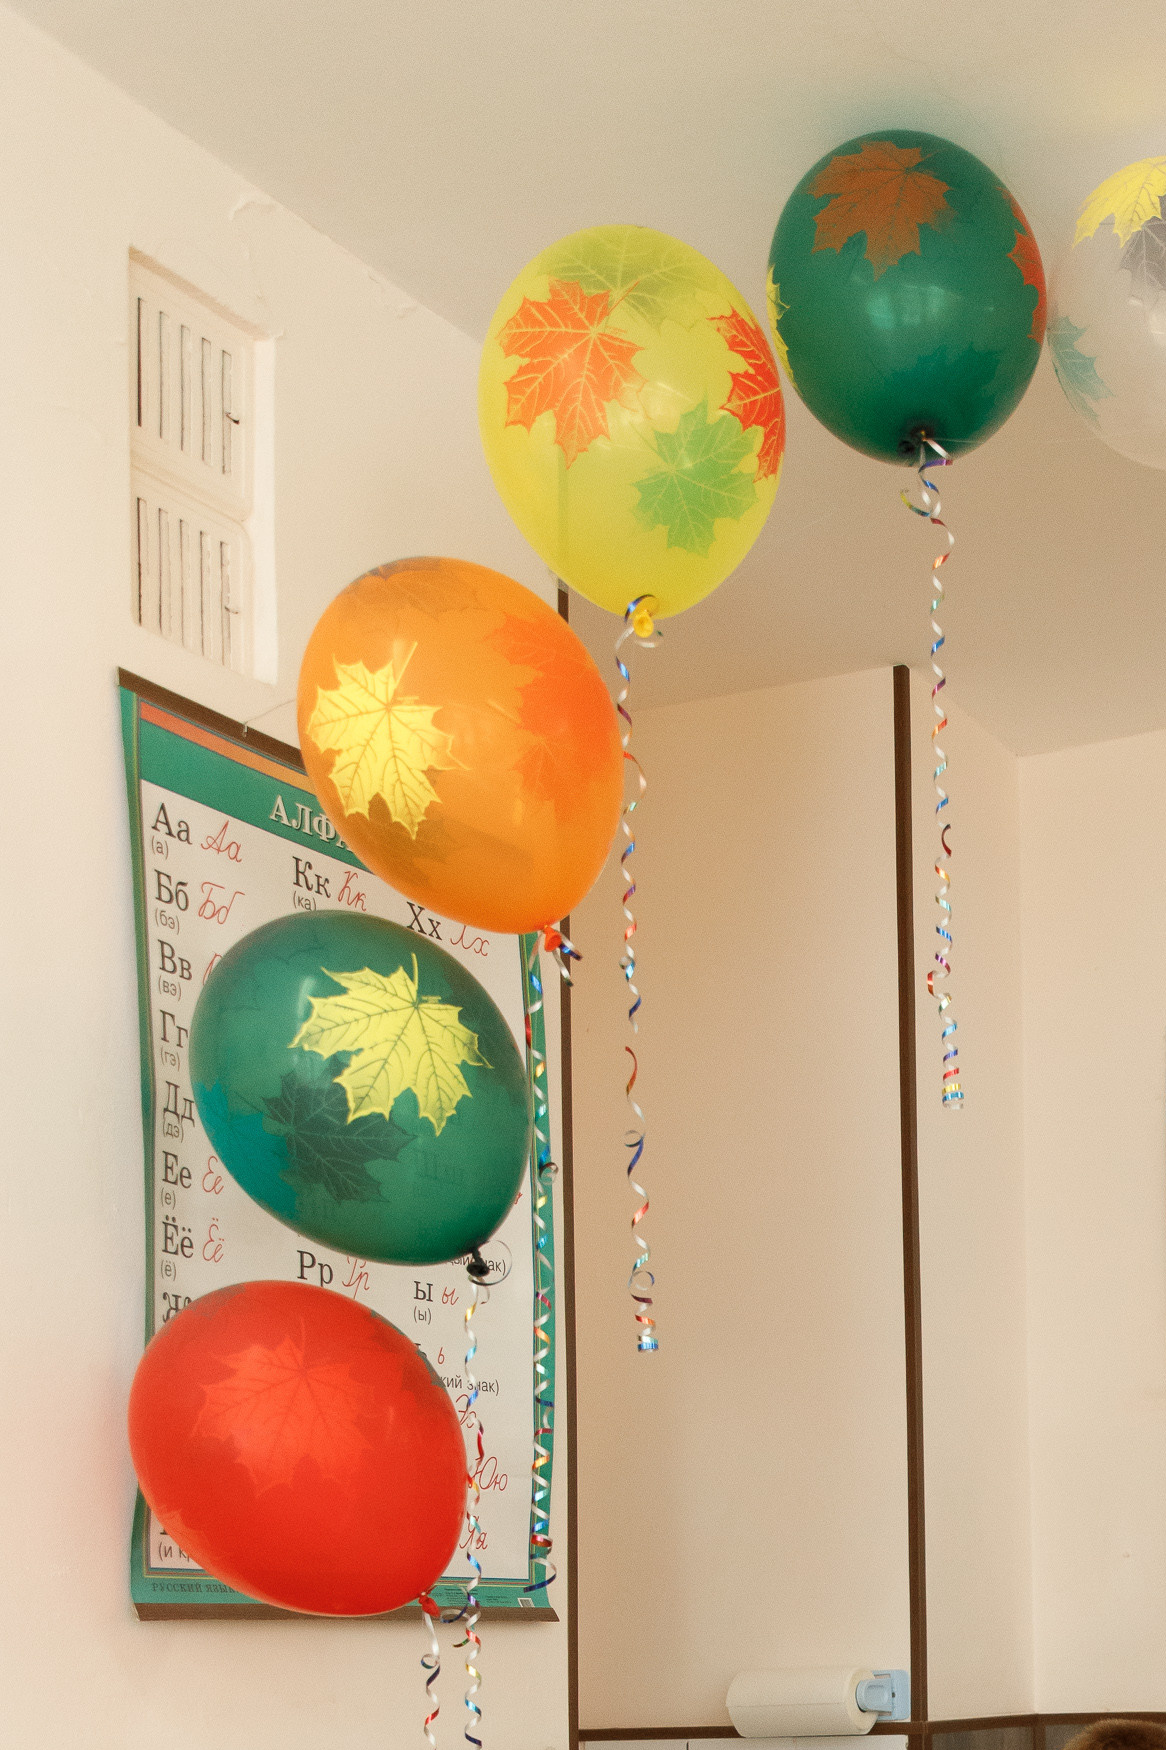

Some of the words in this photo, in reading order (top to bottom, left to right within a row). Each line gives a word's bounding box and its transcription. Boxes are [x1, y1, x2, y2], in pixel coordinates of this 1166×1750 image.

[151, 802, 193, 846] Аа
[200, 820, 242, 863] Аа
[269, 794, 354, 853] АЛФ
[151, 835, 169, 860] (а)
[154, 868, 190, 912] Бб
[198, 881, 246, 925] Бб
[292, 855, 331, 899] Кк
[155, 906, 180, 935] (бэ)
[406, 901, 442, 941] Хх
[157, 938, 193, 982] Вв
[158, 975, 182, 1002] (вэ)
[159, 1009, 189, 1049] Гг
[160, 1047, 181, 1072] (гэ)
[163, 1080, 195, 1127] Дд
[162, 1150, 192, 1189] Ее
[160, 1187, 177, 1210] (е)
[161, 1214, 195, 1259] Ёё
[160, 1259, 177, 1281] (ё)
[413, 1306, 432, 1325] (ы)
